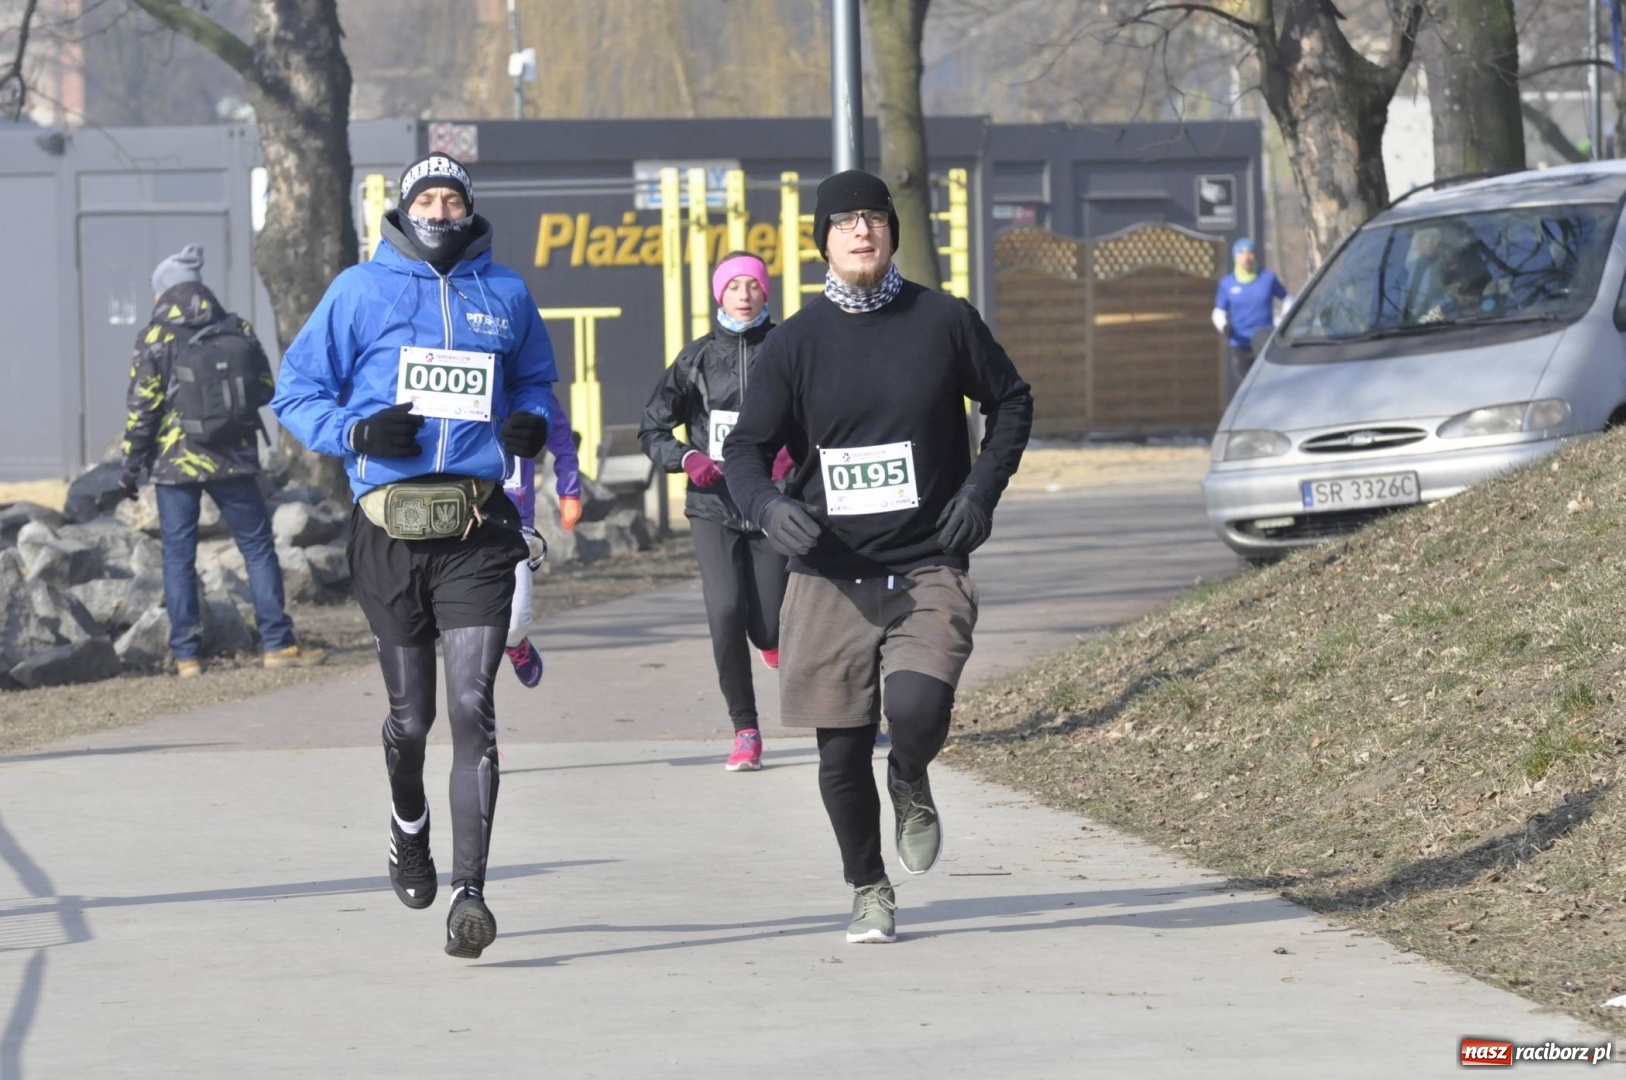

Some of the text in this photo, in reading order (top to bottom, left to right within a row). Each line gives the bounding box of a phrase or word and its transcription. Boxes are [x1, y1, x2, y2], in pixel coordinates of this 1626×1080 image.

[534, 212, 664, 267] Plaża
[409, 365, 484, 394] 0009
[832, 460, 905, 490] 0195
[1315, 475, 1413, 504] SR 3326C
